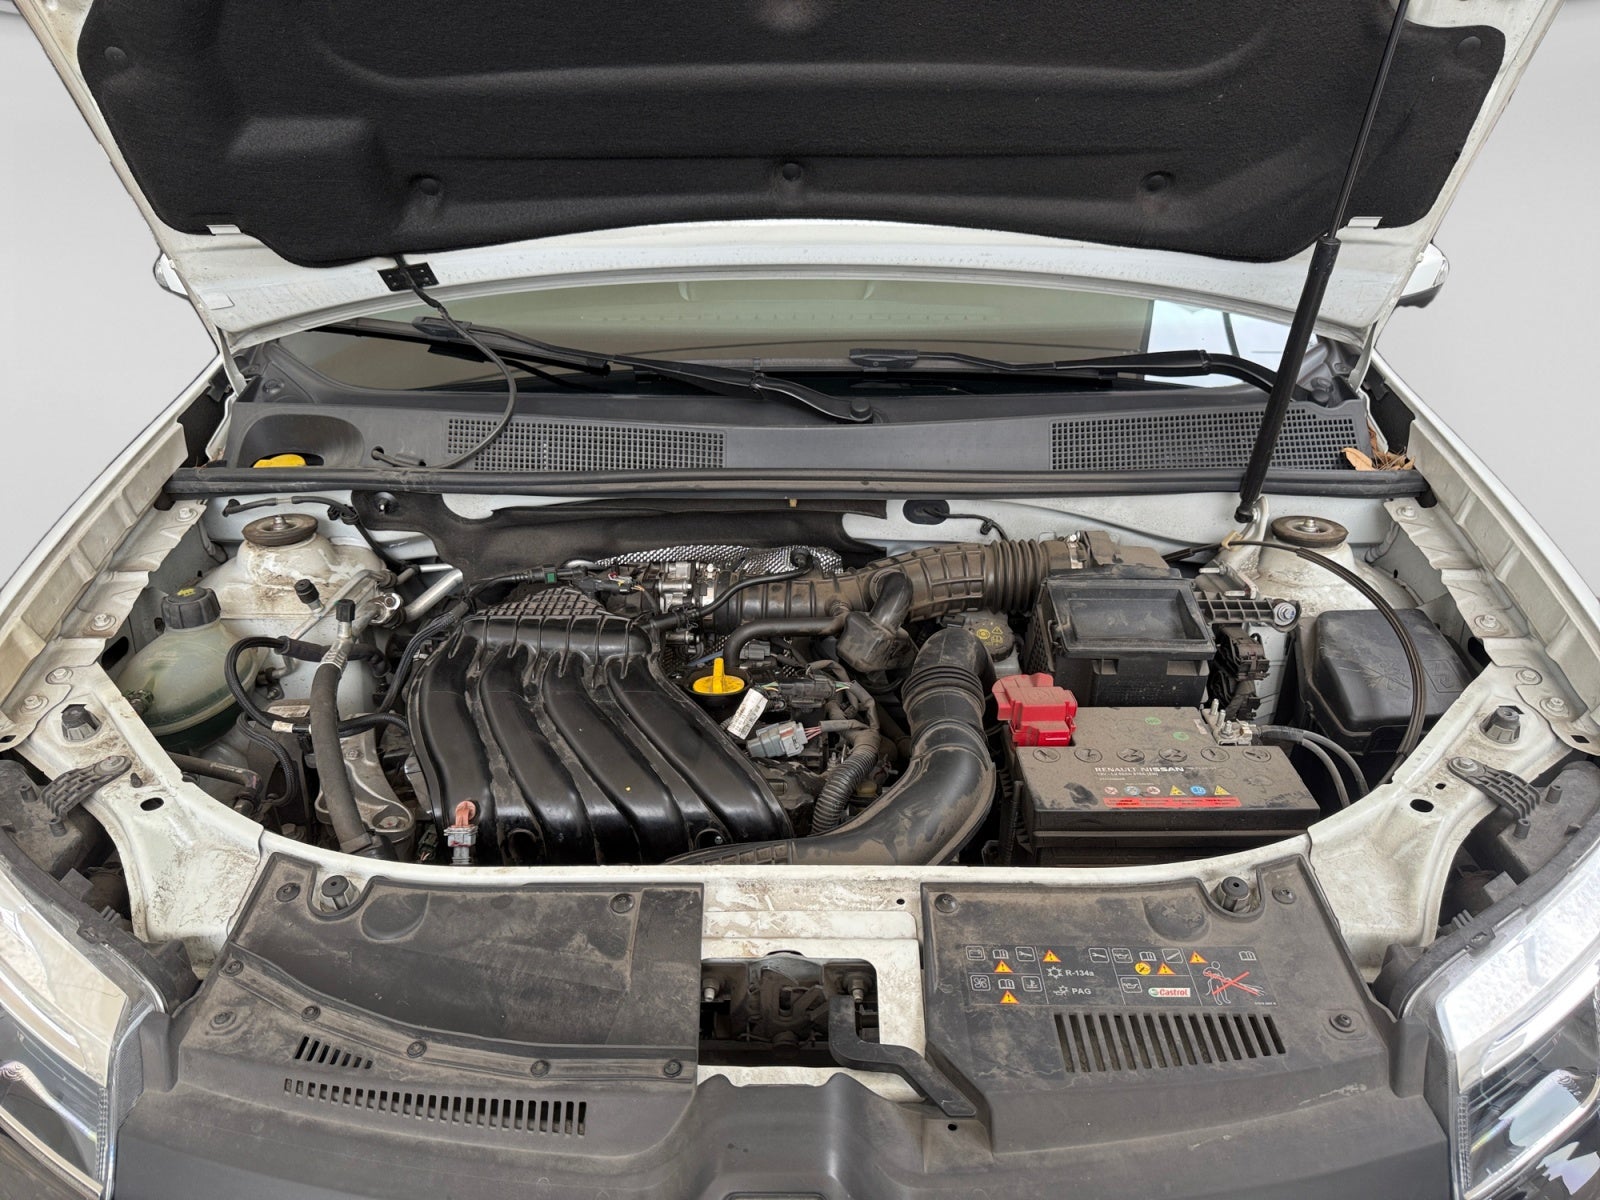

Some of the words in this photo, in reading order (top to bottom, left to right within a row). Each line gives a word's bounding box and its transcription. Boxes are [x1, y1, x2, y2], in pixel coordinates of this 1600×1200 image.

[1065, 969, 1095, 977] R-134a
[1071, 987, 1092, 995] PAG
[1159, 988, 1188, 997] Castrol
